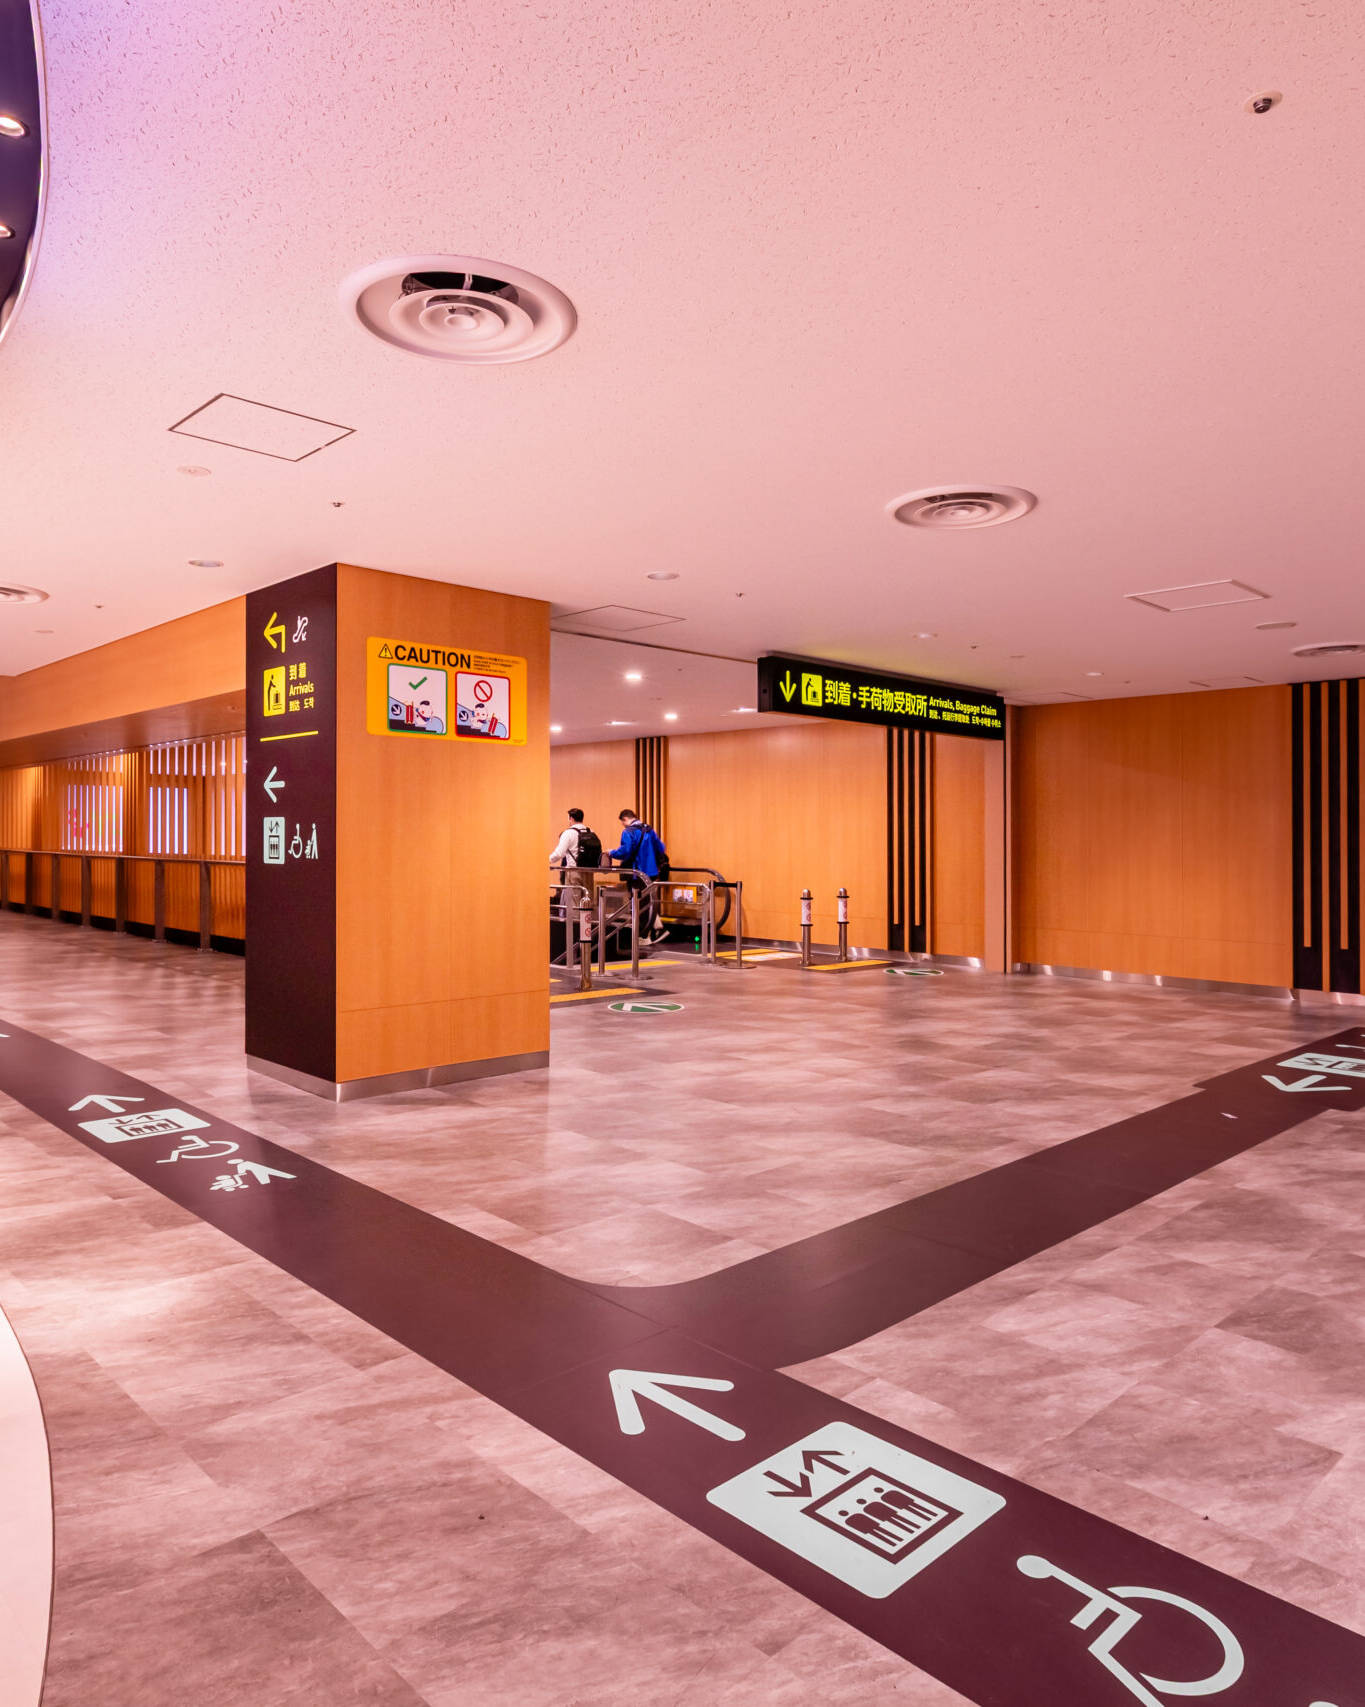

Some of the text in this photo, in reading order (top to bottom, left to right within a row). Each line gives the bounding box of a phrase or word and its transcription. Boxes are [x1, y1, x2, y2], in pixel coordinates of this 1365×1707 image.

[394, 645, 471, 669] CAUTION
[289, 662, 307, 680] 到着
[289, 681, 315, 696] Arrivals
[929, 695, 997, 717] Arrivals, Baggage Claim
